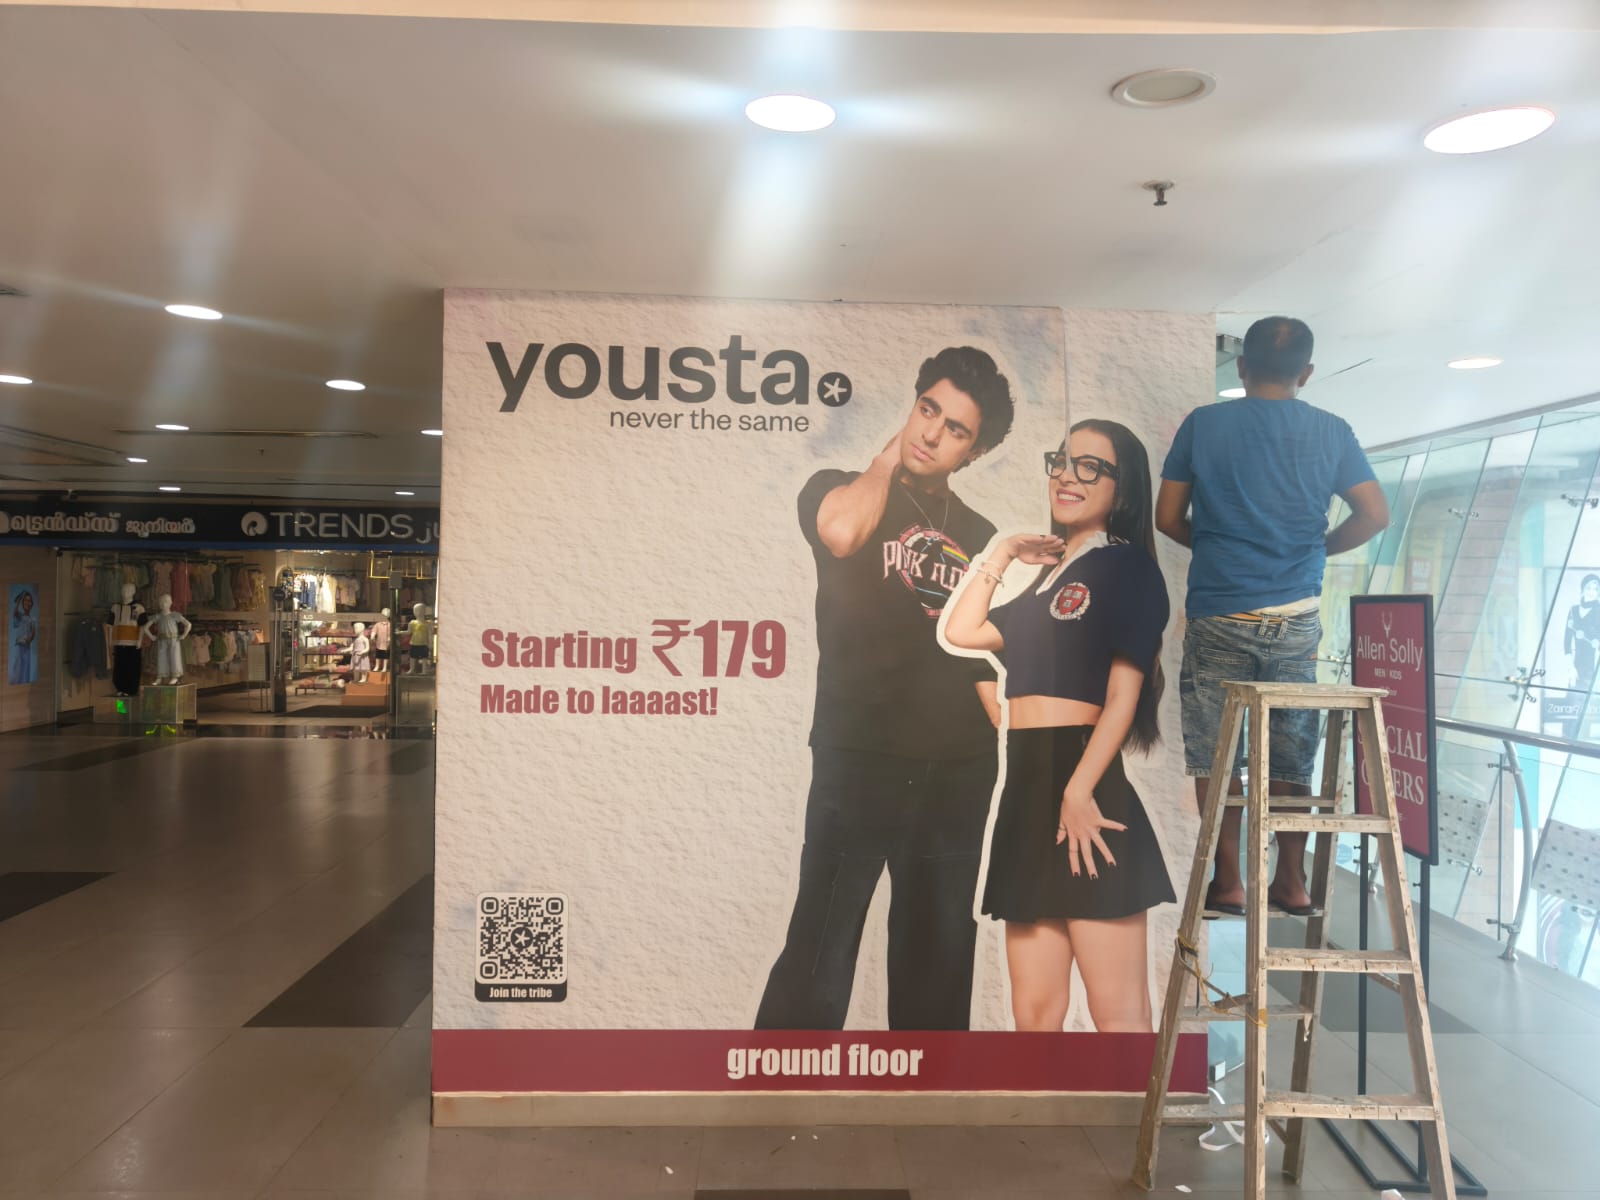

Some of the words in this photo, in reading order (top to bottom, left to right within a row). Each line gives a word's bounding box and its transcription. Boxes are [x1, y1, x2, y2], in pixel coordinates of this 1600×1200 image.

[485, 335, 810, 412] yousta
[610, 410, 684, 429] never
[690, 408, 731, 430] the
[738, 413, 809, 432] same
[270, 511, 413, 538] TRENDS
[883, 540, 929, 581] PINK
[481, 628, 638, 674] Starting
[651, 619, 787, 679] ₹179
[1356, 635, 1386, 661] Allen
[1389, 637, 1423, 672] Solly
[480, 684, 559, 714] Made
[566, 687, 594, 714] to
[601, 685, 718, 716] laaaast!
[489, 987, 509, 998] Join
[511, 987, 527, 998] the
[529, 987, 552, 998] tribe
[727, 1043, 841, 1080] ground
[848, 1043, 924, 1076] floor
